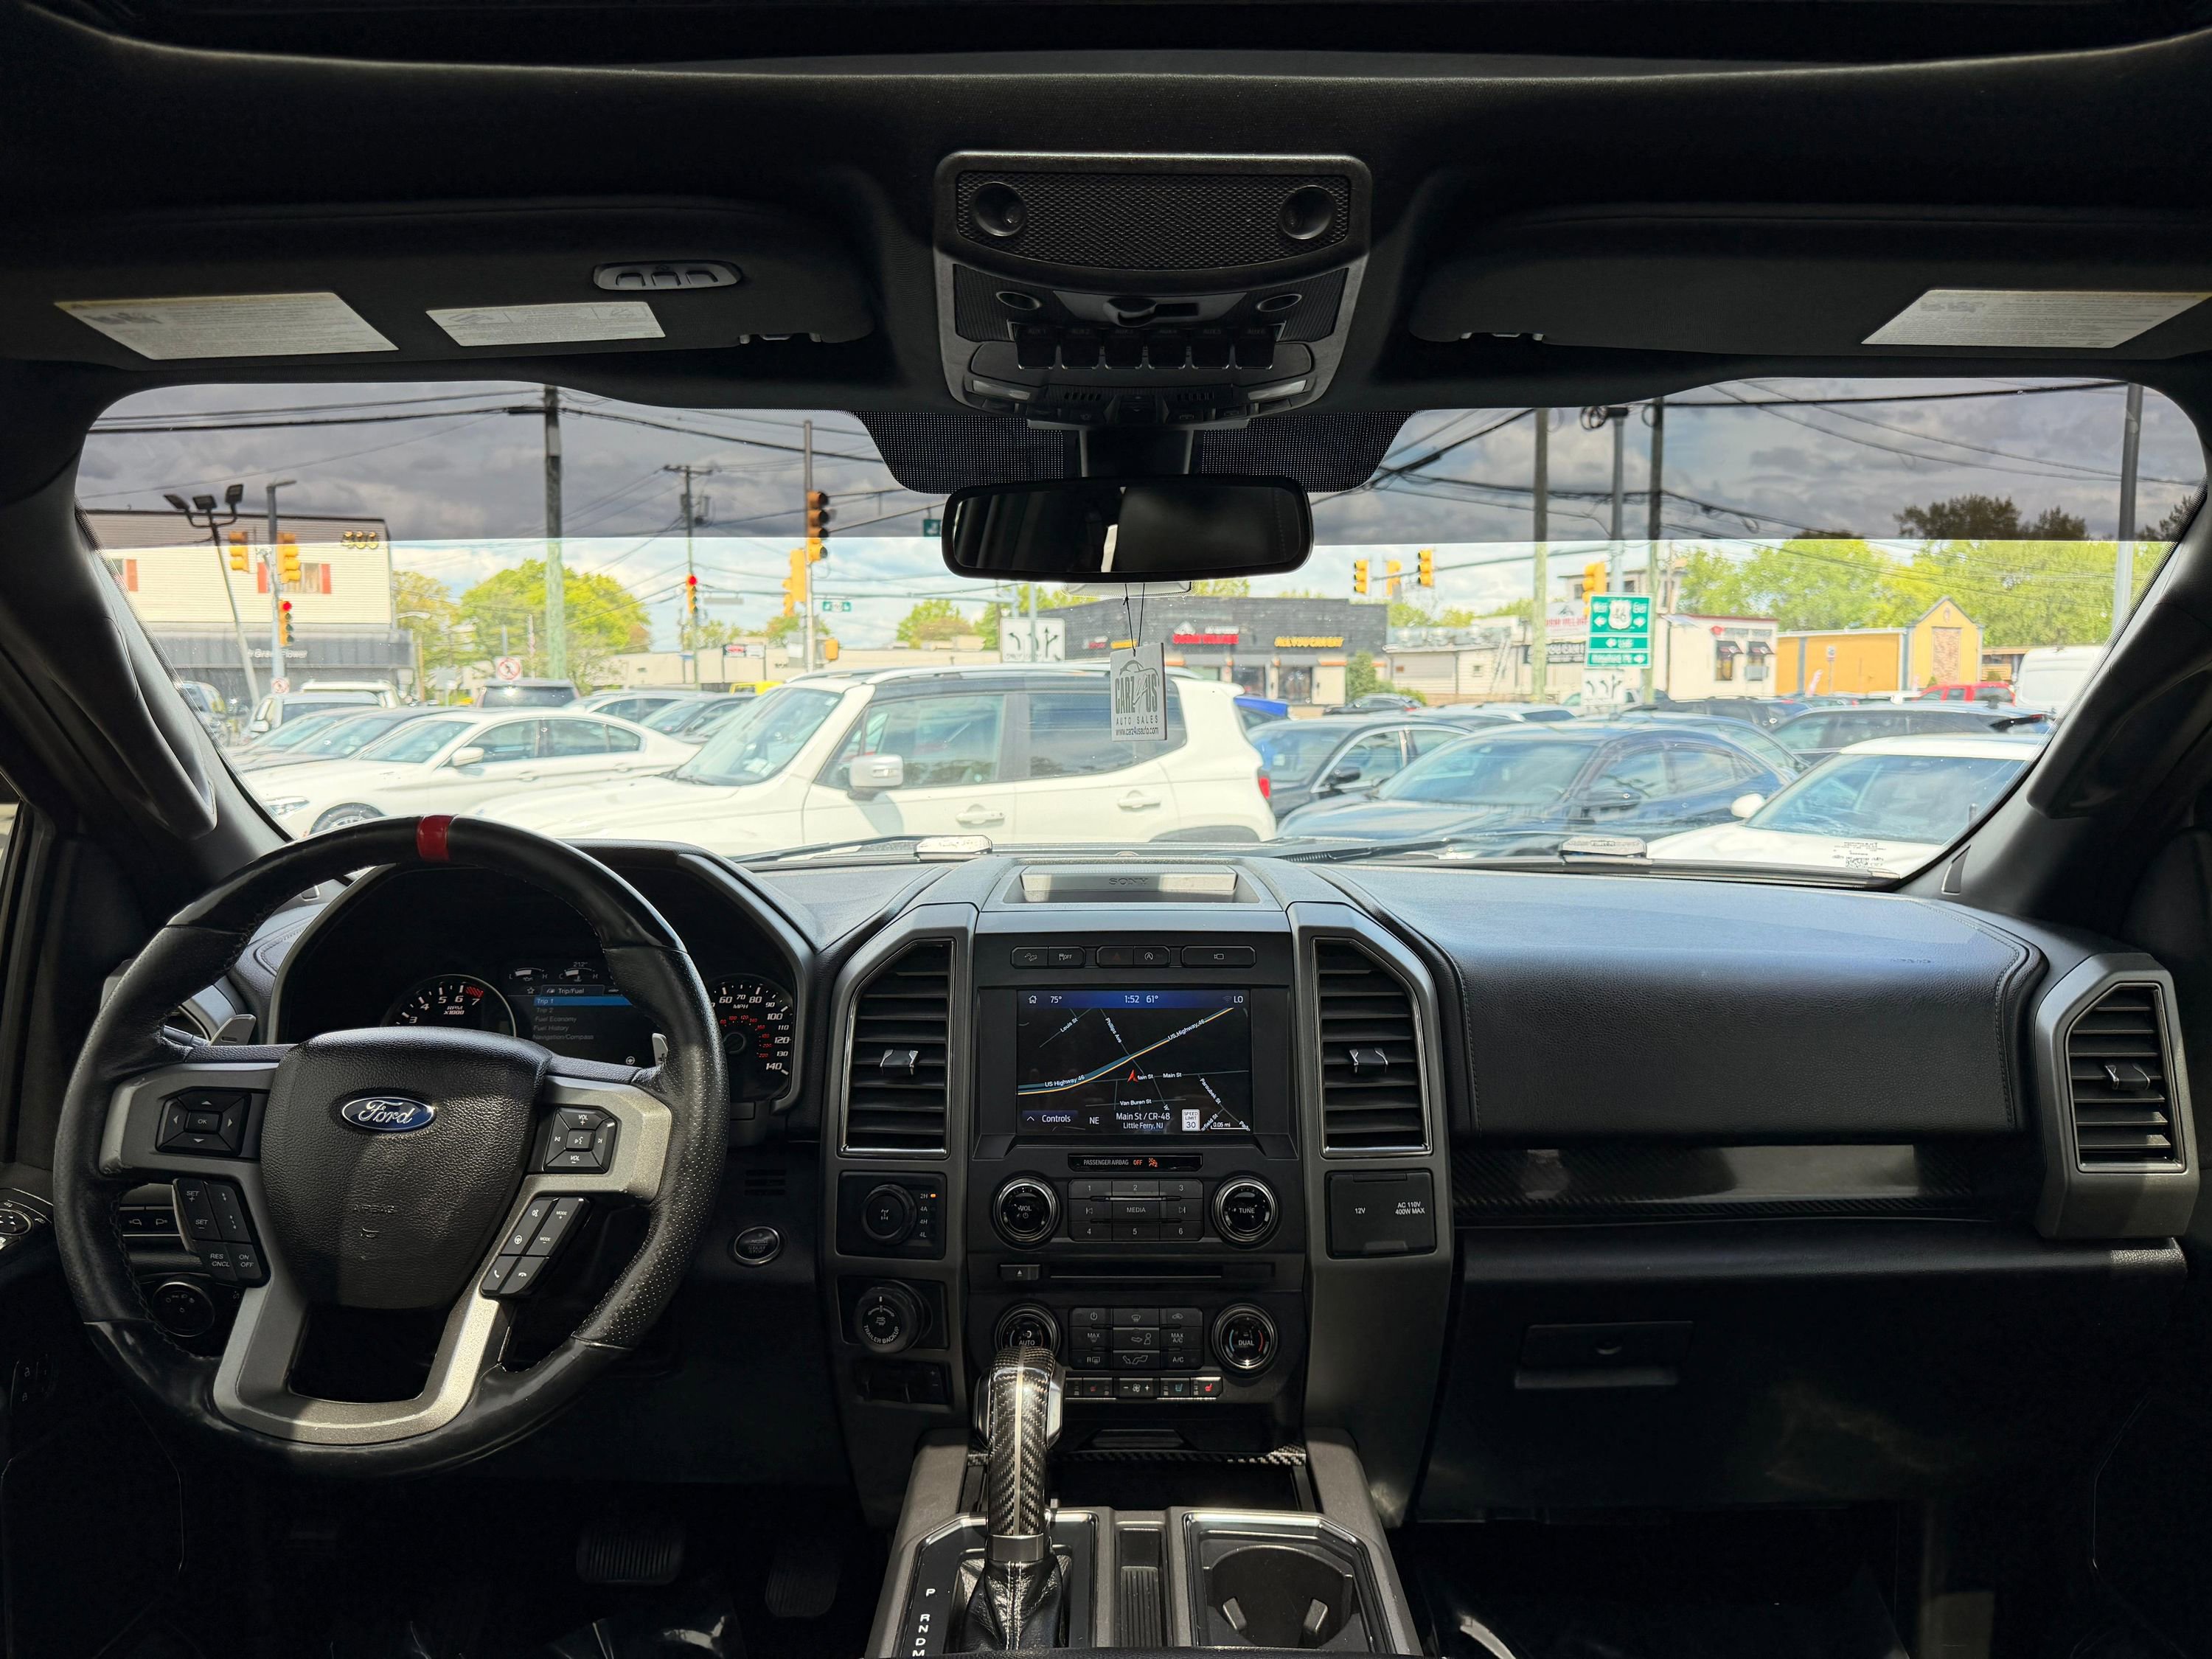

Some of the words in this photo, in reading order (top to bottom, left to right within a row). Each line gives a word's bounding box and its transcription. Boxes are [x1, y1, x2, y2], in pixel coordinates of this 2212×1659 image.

[1116, 717, 1132, 726] AUTO
[1137, 715, 1158, 724] SALES
[1108, 877, 1149, 886] SONY
[1124, 995, 1139, 1004] 1:52
[1234, 995, 1244, 1004] LO
[1060, 1021, 1073, 1033] Louis
[1167, 1033, 1177, 1041] US
[1176, 1022, 1200, 1037] Highway
[1114, 1033, 1122, 1043] Ave
[1054, 1077, 1077, 1088] Highway
[358, 1099, 415, 1124] Ford
[1116, 1112, 1133, 1120] Main
[1134, 1112, 1142, 1120] St
[1148, 1112, 1171, 1120] CR-48
[1041, 1114, 1071, 1123] Controls
[1089, 1116, 1099, 1124] NE
[1139, 1122, 1155, 1130] Ferry,
[863, 1324, 881, 1343] TRAILER
[882, 1326, 900, 1344] BACKUP
[926, 1588, 936, 1597] P
[918, 1624, 928, 1633] N
[915, 1638, 926, 1646] D
[912, 1649, 925, 1657] M
